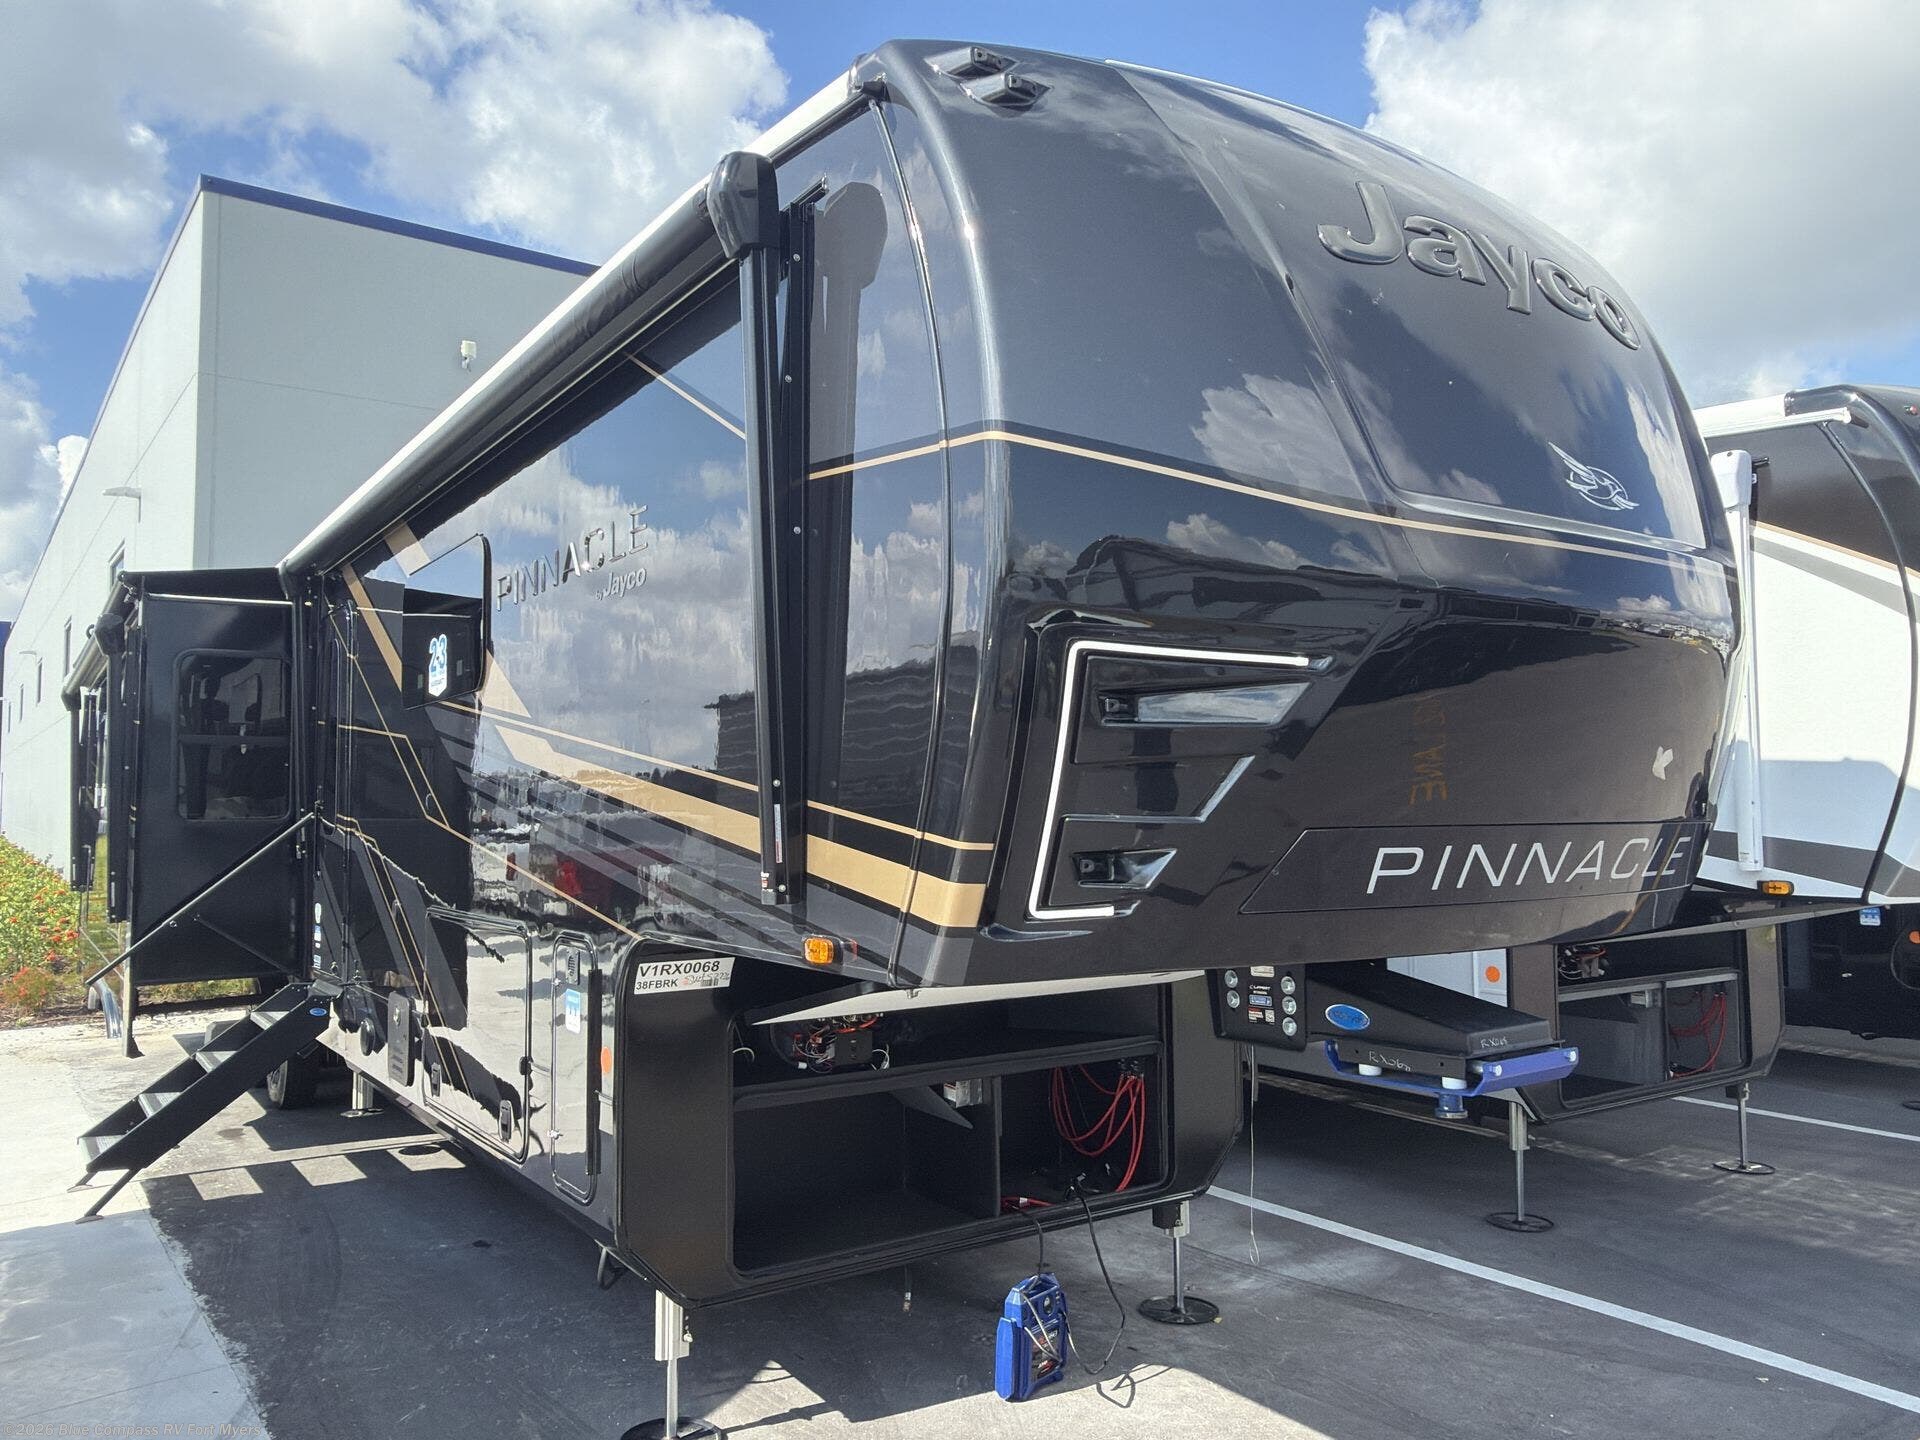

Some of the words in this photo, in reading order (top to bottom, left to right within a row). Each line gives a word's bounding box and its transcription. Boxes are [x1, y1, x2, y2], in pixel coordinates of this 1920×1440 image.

[1315, 180, 1641, 351] Jayco
[496, 504, 649, 613] PINNACLE
[603, 568, 647, 598] Jayco
[1366, 836, 1692, 895] PINNACLE
[635, 978, 679, 991] 38FBRK
[639, 960, 720, 977] V1RX0068
